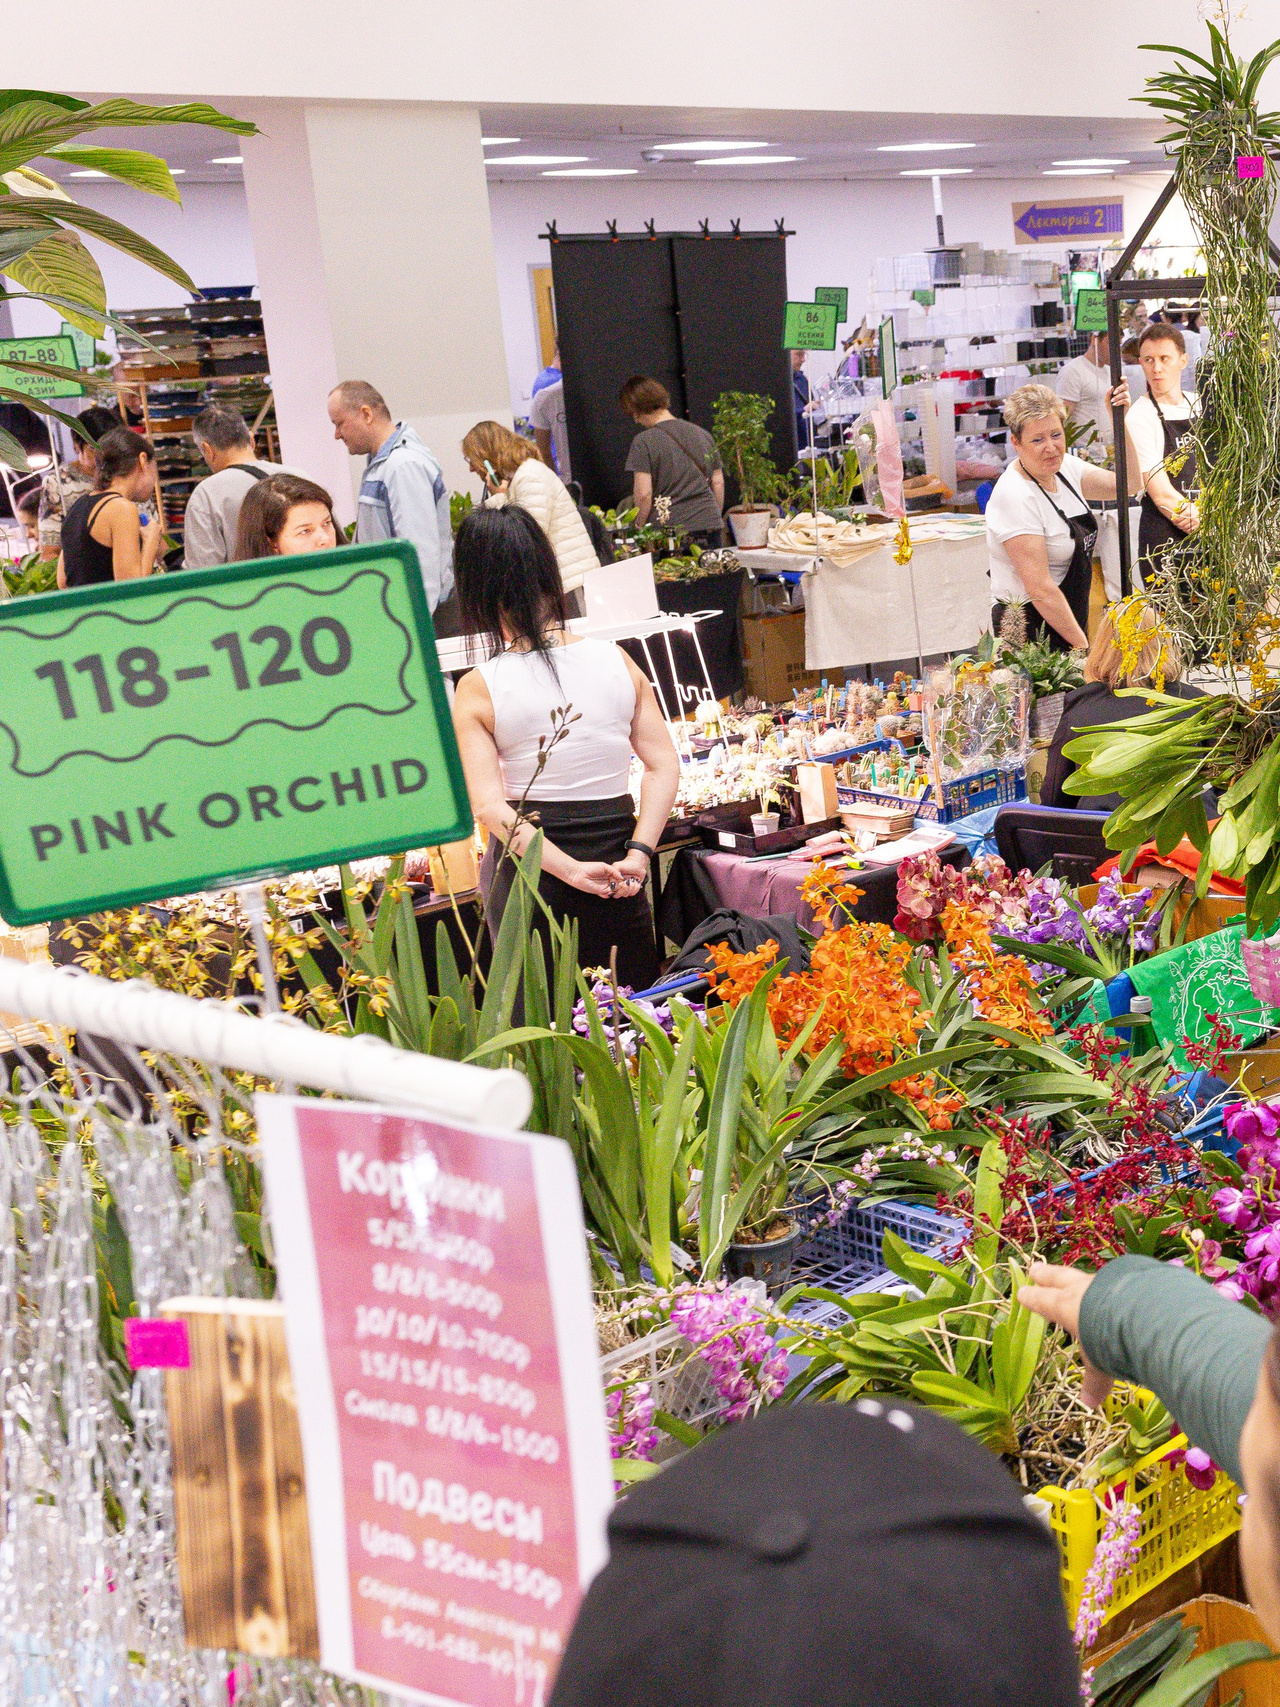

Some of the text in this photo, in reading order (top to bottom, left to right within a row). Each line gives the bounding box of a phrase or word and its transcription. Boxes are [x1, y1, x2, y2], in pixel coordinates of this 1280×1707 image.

[1026, 208, 1104, 232] Лекторий 2
[806, 312, 818, 323] 86
[9, 348, 57, 362] 87-88
[34, 616, 352, 721] 118-120
[30, 758, 429, 861] PINK ORCHID
[337, 1151, 506, 1222] Коринки
[373, 1460, 543, 1545] Подвесы
[360, 1520, 415, 1562] Цепь
